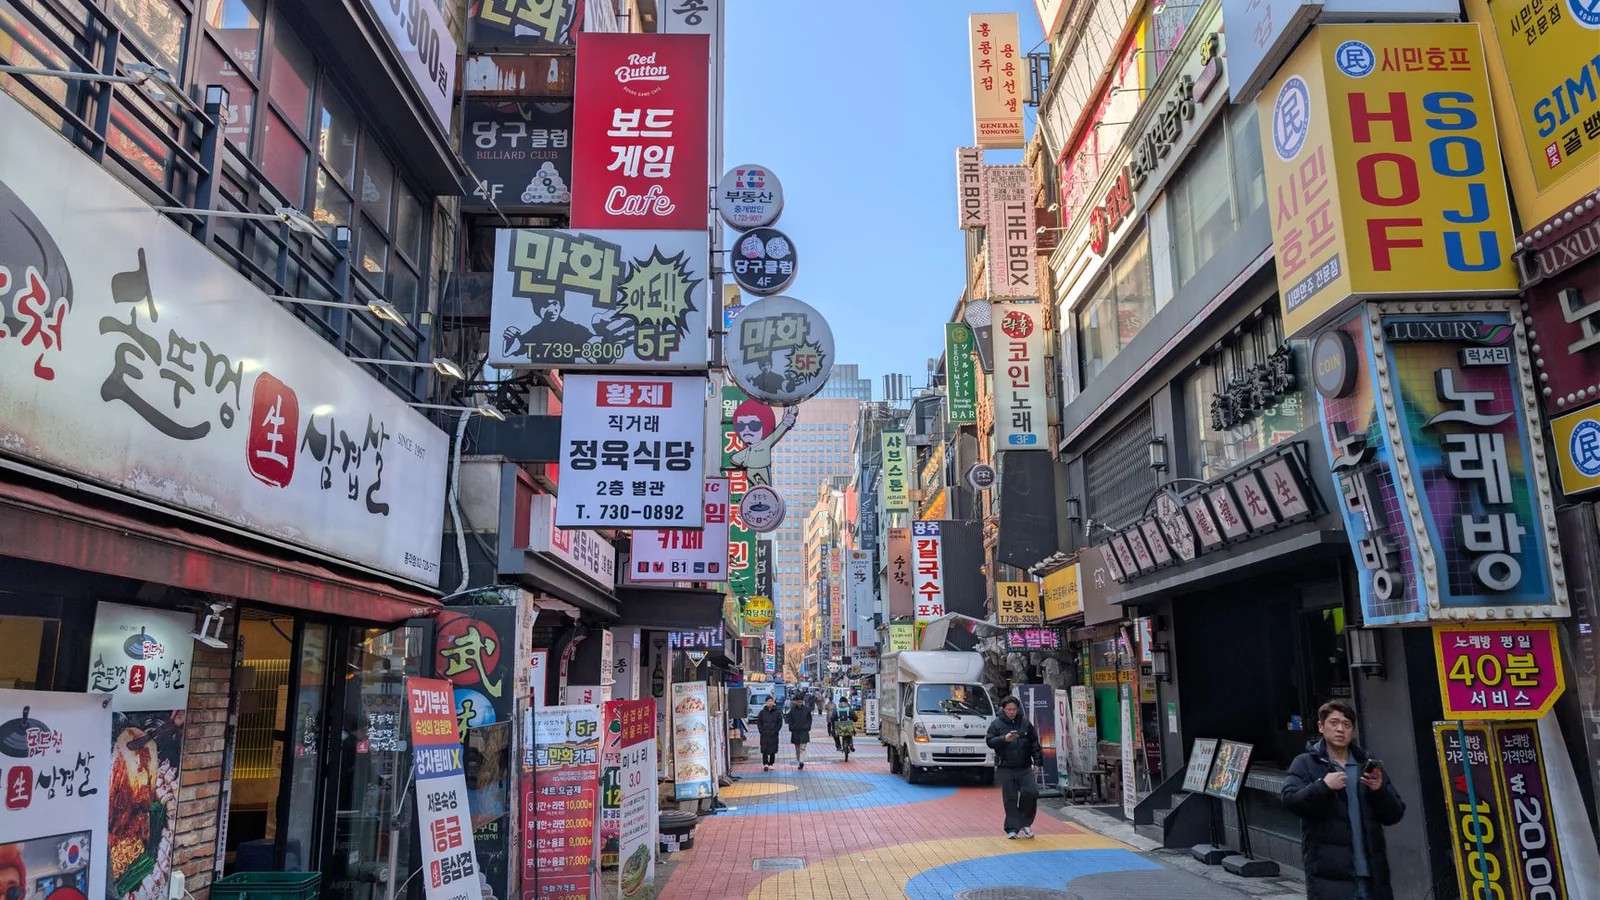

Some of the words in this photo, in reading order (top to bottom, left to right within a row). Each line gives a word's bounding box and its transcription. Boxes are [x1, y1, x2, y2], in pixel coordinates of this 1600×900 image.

[1510, 0, 1550, 36] 시민안
[1525, 4, 1562, 46] 전문점
[628, 52, 656, 65] Red
[977, 22, 993, 91] 홍콩주점
[1346, 49, 1368, 69] 民
[1382, 47, 1471, 72] 시민호프
[615, 65, 670, 83] Button
[1000, 43, 1017, 113] 용용선생
[607, 108, 674, 137] 보드
[1132, 75, 1196, 191] 노래연습장
[476, 151, 526, 160] BILLIARD
[531, 151, 558, 159] CLUB
[607, 145, 674, 178] 게임
[963, 151, 979, 183] THE
[473, 180, 504, 200] 4F
[1277, 144, 1327, 231] 시민
[1348, 91, 1424, 271] HOF
[1422, 91, 1502, 272] SOJU
[605, 185, 675, 216] Cafe
[725, 191, 774, 203] 부동산
[964, 187, 981, 221] BOX
[1105, 165, 1133, 232] 코인
[1007, 201, 1027, 240] THE
[1280, 198, 1337, 281] 호프
[511, 229, 620, 307] 만화
[734, 260, 793, 275] 당구클럽
[1009, 245, 1029, 286] BOX
[756, 277, 771, 286] 4F
[1287, 275, 1315, 310] 시민안주
[1316, 259, 1339, 286] 전문점
[636, 328, 677, 358] 5F
[742, 313, 810, 364] 만화
[1389, 322, 1483, 340] LUXURY
[99, 247, 243, 441] 솥뚜껑
[525, 343, 624, 360] T.739-8800
[1468, 348, 1510, 363] 럭셔리
[795, 354, 817, 369] 5F
[961, 344, 970, 397] ソウルメイト
[1317, 353, 1341, 377] COIN
[606, 383, 664, 405] 황제
[953, 374, 961, 398] MATE
[1008, 341, 1032, 433] 코인노래
[609, 415, 660, 432] 직거래
[951, 411, 976, 419] BAR
[256, 394, 290, 470] 生
[1015, 434, 1029, 444] 3F
[301, 413, 391, 516] 삼겹살
[570, 440, 695, 471] 정육식당
[886, 435, 904, 493] 샤브스톤
[596, 482, 625, 496] 2층
[632, 482, 665, 496] 별관
[1420, 367, 1527, 591] 노래방
[576, 504, 590, 519] T.
[599, 504, 685, 520] 730-0892
[1331, 421, 1395, 600] 노래방
[657, 530, 703, 550] 카페
[914, 521, 940, 536] 공주
[671, 561, 687, 573] B1
[917, 539, 941, 602] 칼국수
[1007, 586, 1029, 597] 하나
[918, 604, 943, 617] 포차
[1002, 601, 1035, 613] 부동산
[1453, 635, 1491, 649] 노래방
[1500, 635, 1531, 648] 평일
[441, 625, 502, 698] 武
[1449, 653, 1540, 687] 40분
[412, 688, 450, 715] 고기부심
[1471, 690, 1531, 708] 서비스
[623, 705, 650, 724] 삼겹살과
[415, 719, 434, 736] 숙성의
[434, 719, 452, 736] 감칠맛
[577, 721, 596, 735] 5F
[622, 722, 650, 740] 어울리는
[1504, 734, 1530, 748] 노래방
[622, 747, 648, 769] 미나리
[1503, 749, 1536, 763] 가격인하
[35, 752, 98, 800] 삼겹살
[629, 770, 641, 788] 3.0
[427, 790, 458, 813] 저온숙성
[541, 786, 557, 796] 세트
[558, 785, 582, 796] 요금제
